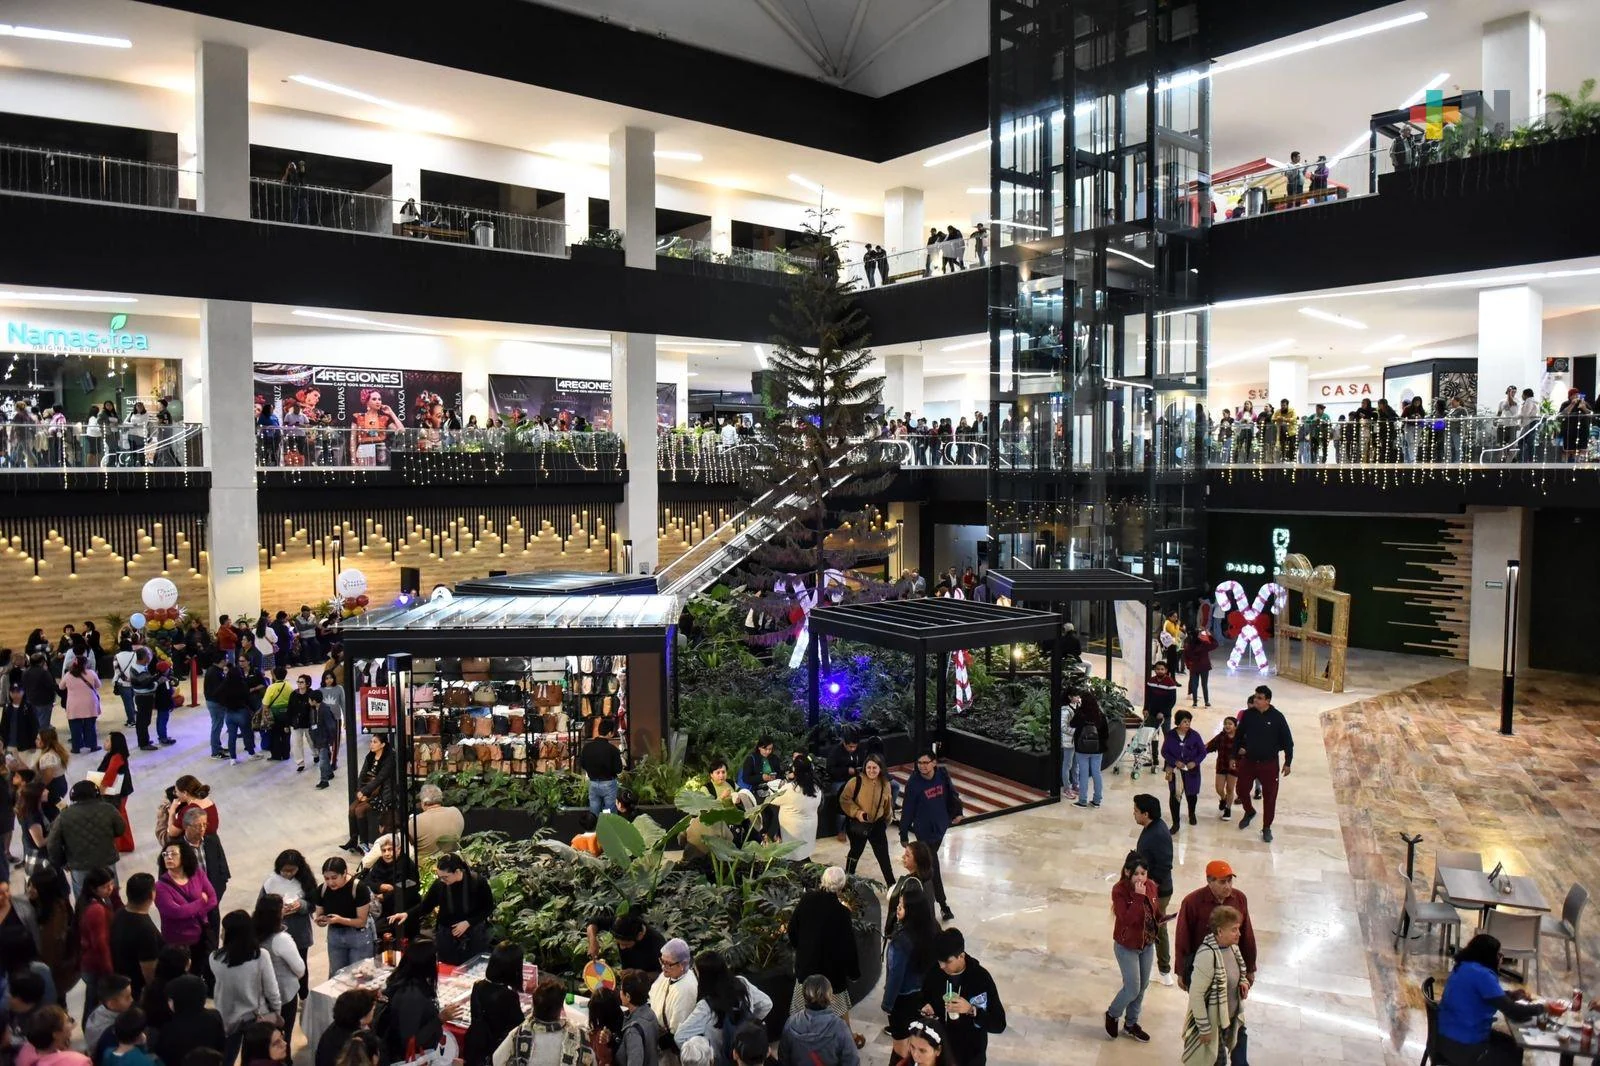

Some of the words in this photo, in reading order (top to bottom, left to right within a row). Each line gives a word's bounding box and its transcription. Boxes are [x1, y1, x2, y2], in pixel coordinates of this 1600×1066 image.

[316, 369, 400, 384] 4REGIONES
[1321, 383, 1372, 397] CASA
[338, 386, 346, 421] CHIAPAS
[398, 389, 406, 421] OAXACA
[1225, 562, 1266, 575] PASEO
